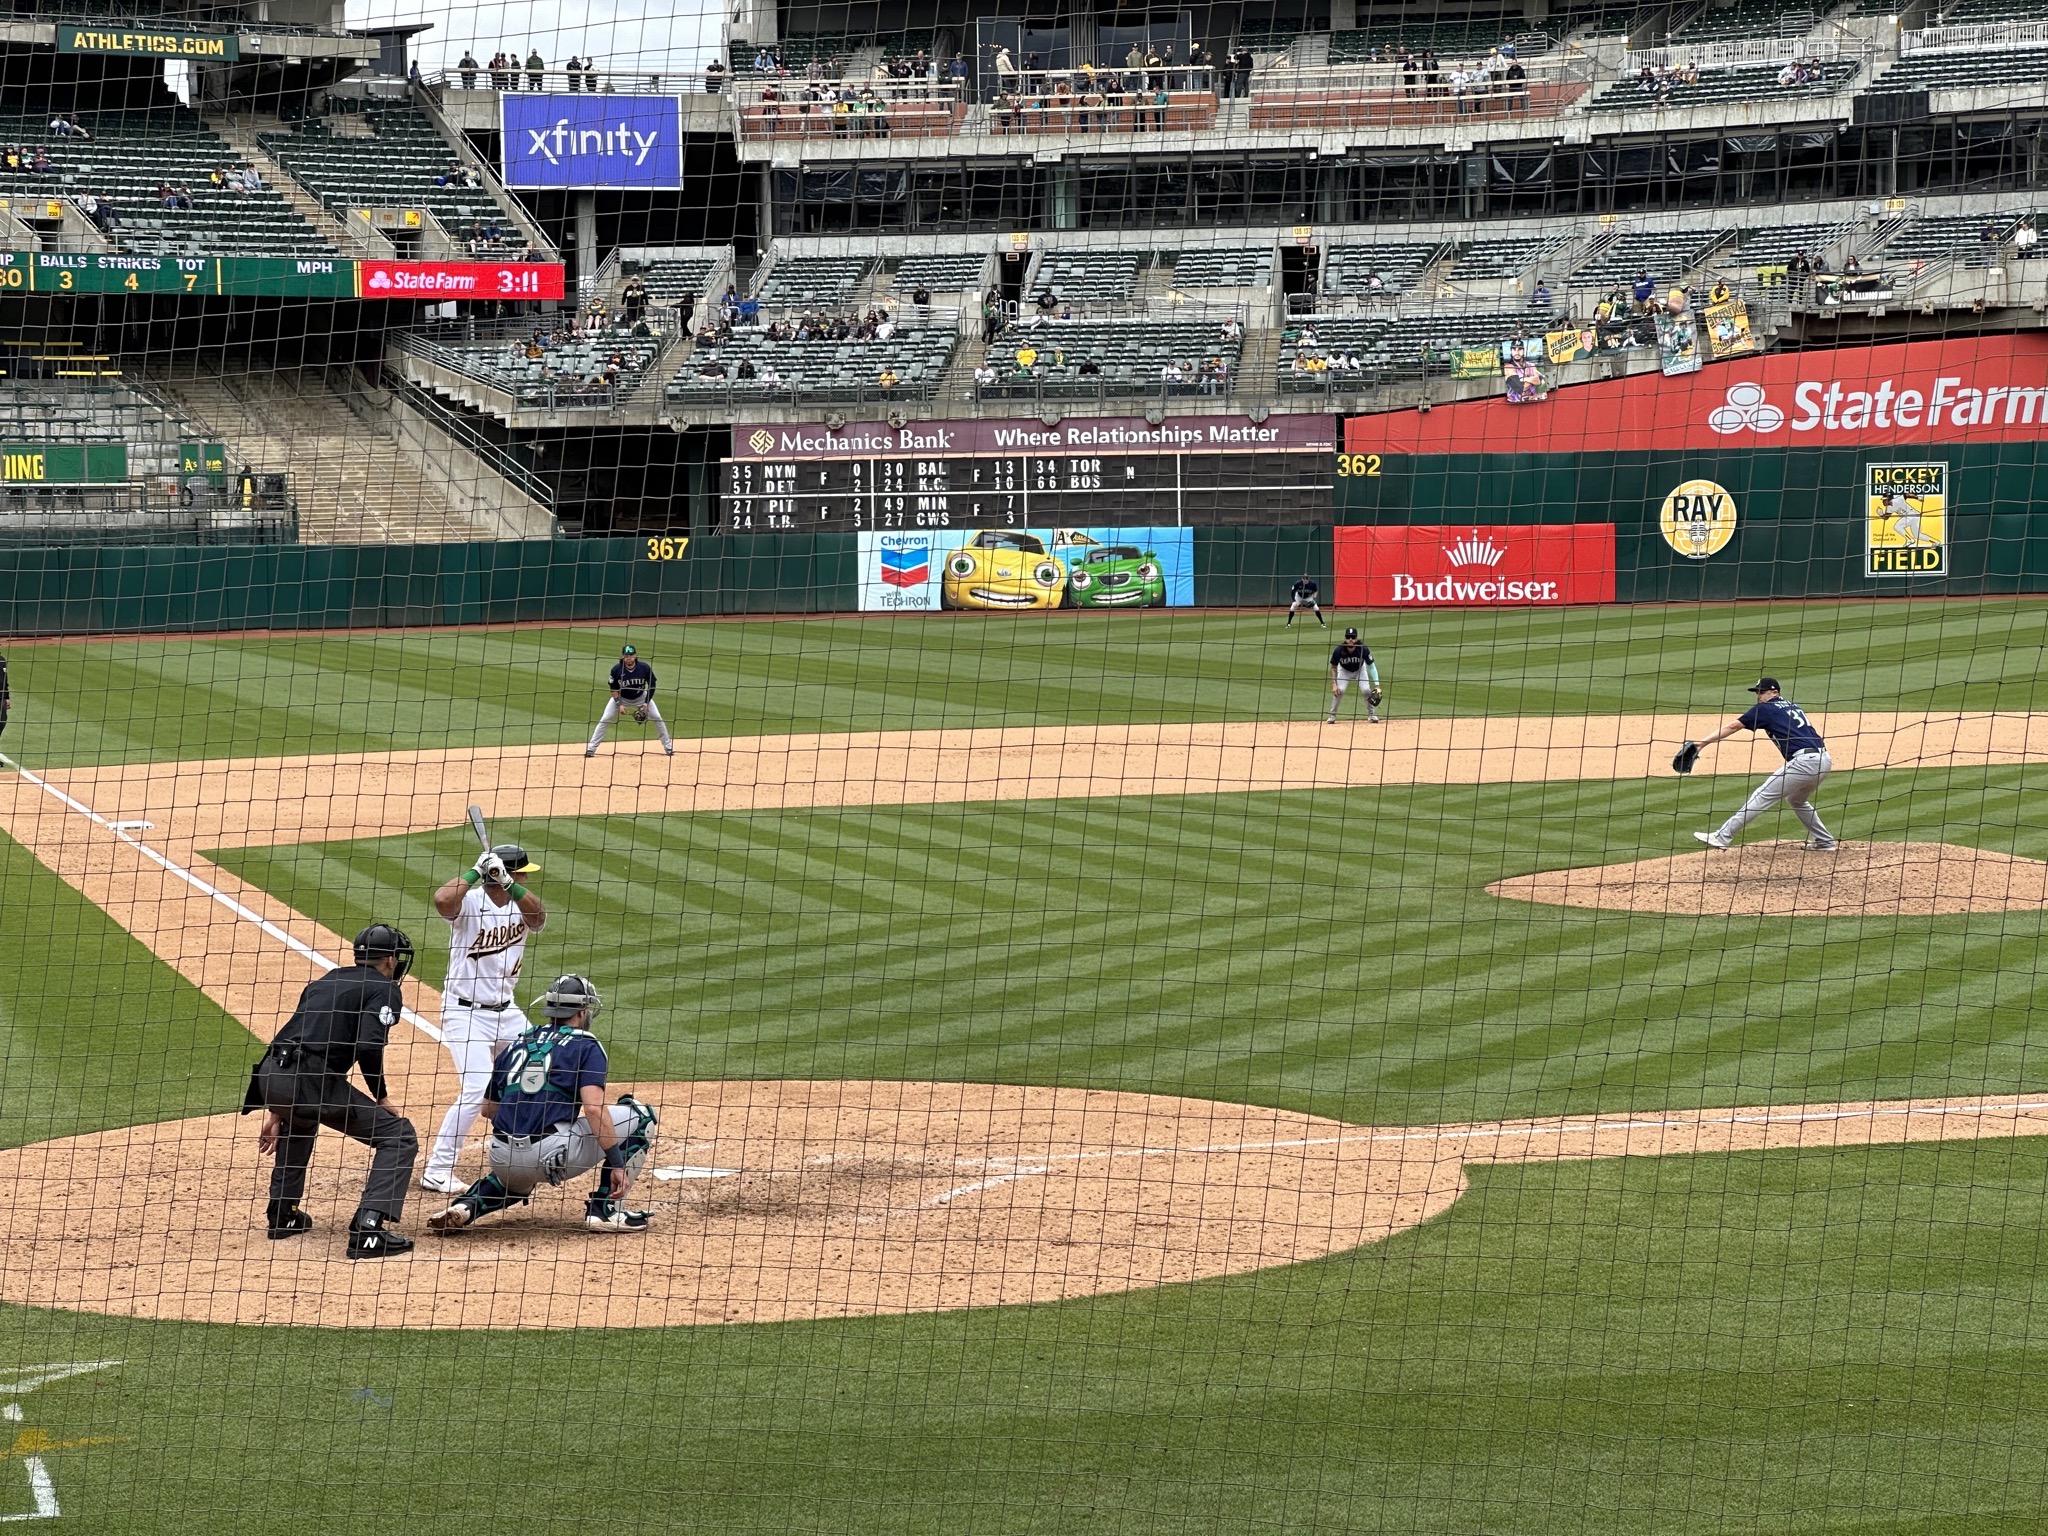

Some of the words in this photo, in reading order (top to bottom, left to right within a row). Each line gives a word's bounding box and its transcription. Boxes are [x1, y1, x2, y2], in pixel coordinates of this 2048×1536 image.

[73, 32, 224, 56] ATHLETICS.COM
[528, 118, 657, 166] xfinity
[40, 254, 87, 268] BALLS
[98, 255, 161, 270] STRIKES
[176, 258, 205, 271] TOT
[296, 261, 333, 274] MPH
[59, 271, 73, 289] 3
[124, 273, 139, 290] 4
[183, 274, 198, 291] 7
[497, 270, 538, 293] 3:11
[780, 431, 893, 452] Mechanics
[899, 429, 951, 450] Bank
[994, 429, 1061, 446] Where
[1068, 426, 1203, 448] Relationships
[1210, 426, 1279, 443] Matter
[732, 465, 752, 479] 35
[764, 464, 796, 478] NYM
[853, 463, 861, 477] 0
[884, 462, 904, 476] 30
[918, 461, 947, 475] BAL
[994, 460, 1014, 474] 13
[1036, 460, 1056, 474] 34
[1070, 459, 1101, 473] TOR
[1126, 466, 1135, 479] N
[1337, 454, 1382, 476] 362
[820, 472, 827, 485] F
[884, 478, 904, 491] 24
[919, 477, 946, 491] K.C.
[994, 476, 1014, 490] 10
[973, 469, 980, 482] F
[1037, 476, 1057, 489] 66
[1070, 475, 1101, 488] BOS
[1874, 468, 1940, 484] RICKEY
[733, 481, 752, 494] 57
[765, 480, 795, 493] DET
[854, 479, 861, 492] 2
[1874, 483, 1940, 494] HENDERSON
[733, 500, 752, 513] 27
[769, 499, 794, 513] PIT
[854, 498, 861, 511] 2
[884, 497, 904, 511] 49
[918, 496, 947, 510] MIN
[1006, 495, 1014, 509] 7
[973, 503, 980, 516] F
[1672, 494, 1724, 522] RAY
[733, 515, 752, 529] 24
[767, 515, 795, 528] T.B.
[854, 513, 861, 527] 3
[821, 506, 828, 520] F
[884, 513, 904, 526] 27
[916, 512, 950, 526] CWS
[1006, 511, 1014, 524] 3
[647, 537, 689, 560] 367
[881, 536, 929, 546] Chevron
[1873, 549, 1940, 571] FIELD
[1391, 574, 1555, 601] Budweiser
[880, 596, 931, 608] TECHRON
